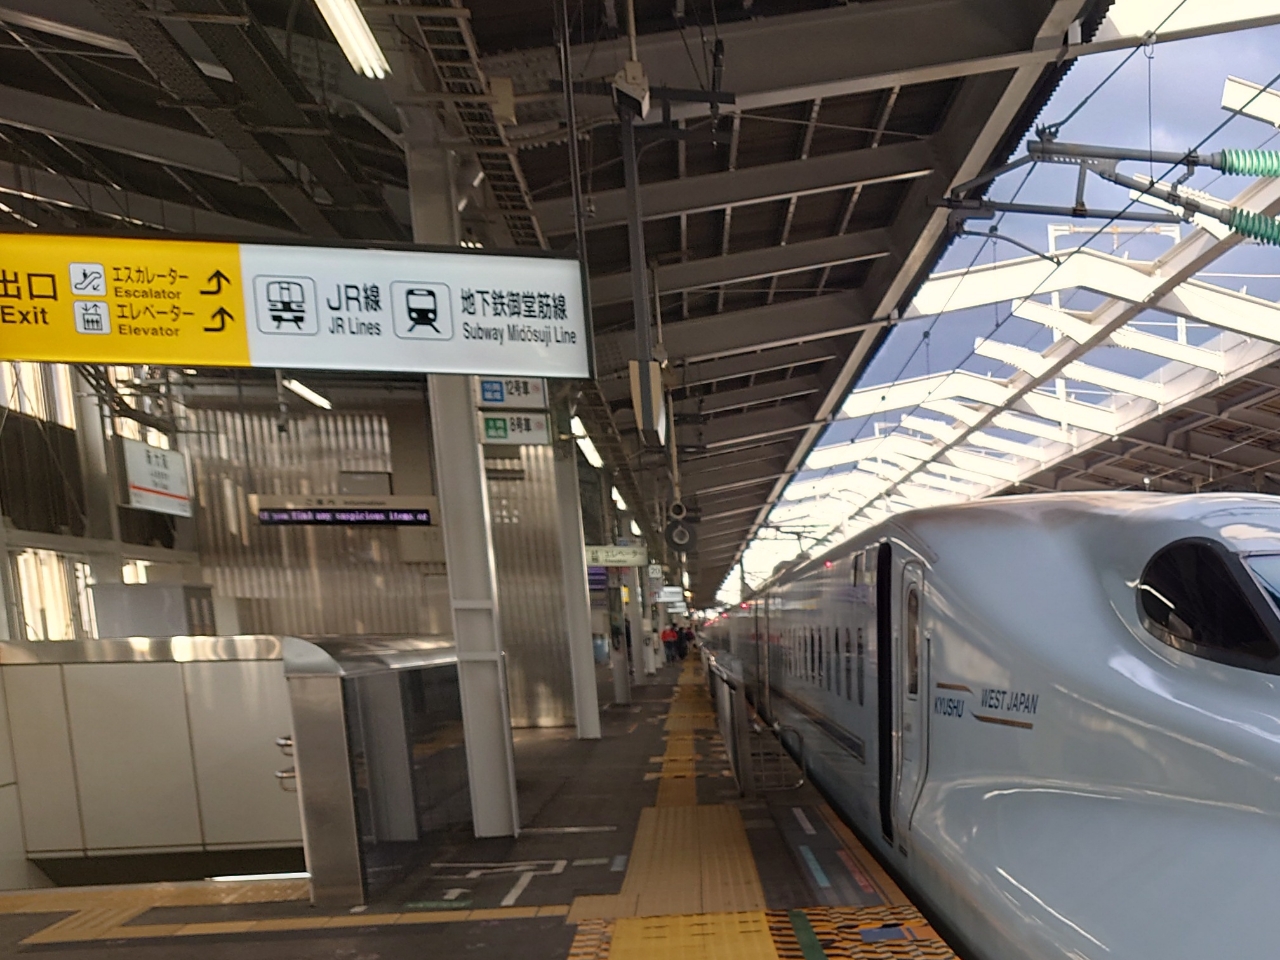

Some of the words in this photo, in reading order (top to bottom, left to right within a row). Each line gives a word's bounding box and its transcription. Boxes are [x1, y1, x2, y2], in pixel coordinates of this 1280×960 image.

[0, 269, 58, 301] 出口
[112, 266, 189, 285] エスカレーター
[114, 286, 181, 300] Escalator
[327, 282, 382, 313] JR線
[117, 303, 195, 322] エレベーター
[460, 287, 569, 321] 地下鉄御堂筋線
[1, 305, 49, 325] Exit
[118, 324, 180, 337] Elevator
[328, 317, 346, 336] JR
[349, 317, 382, 337] Lines
[462, 322, 505, 346] Subway
[507, 324, 552, 348] Midōsuji
[554, 326, 577, 345] Line
[651, 567, 660, 575] 20
[934, 697, 965, 718] KYUSHU
[981, 688, 1007, 710] WEST
[1007, 691, 1039, 714] JAPAN
